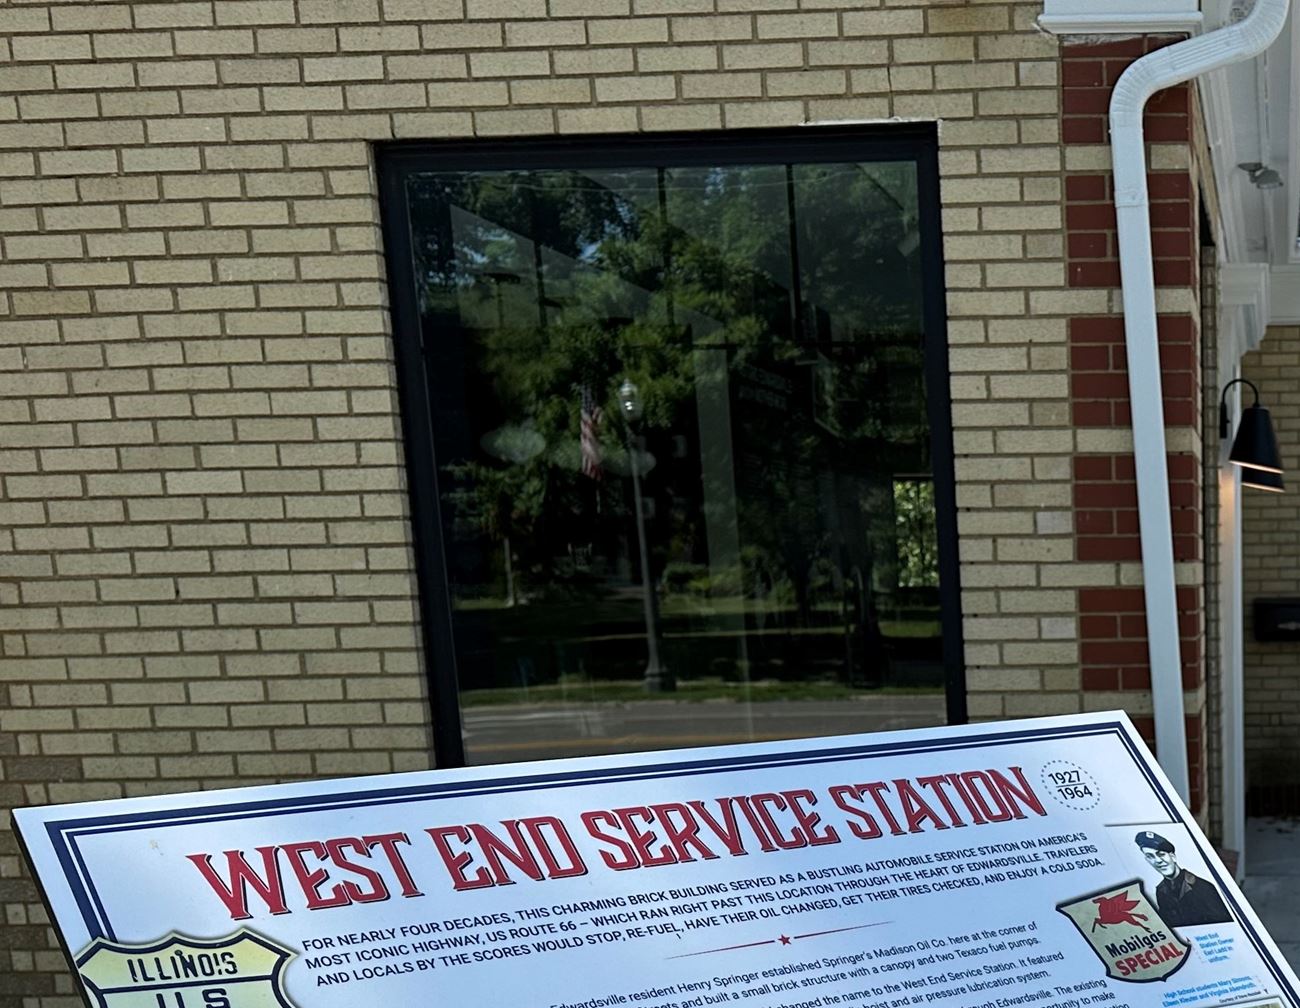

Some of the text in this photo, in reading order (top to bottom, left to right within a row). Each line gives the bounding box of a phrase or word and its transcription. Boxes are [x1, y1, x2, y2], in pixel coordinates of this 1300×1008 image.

[1047, 769, 1085, 787] 1927
[1057, 784, 1093, 800] 1964
[185, 766, 1048, 921] WEST END SERVICE STATION
[301, 832, 1087, 951] FOR NEARLY FOUR DECADES, THIS CHARMING BRICK BUILDING SERVED AS A BUSTLING AUTOMOBILE SERVICE STATION ON AMERICA'S
[628, 985, 677, 1002] resident
[676, 980, 712, 993] Henry
[712, 971, 759, 987] Springer
[761, 959, 822, 978] established
[821, 951, 873, 968] Springer's
[872, 944, 917, 958] Madison
[916, 939, 931, 950] Oil
[930, 938, 949, 948] Co.
[947, 935, 970, 945] here
[970, 932, 982, 941] at
[980, 929, 998, 939] the
[998, 924, 1026, 936] corner
[1027, 920, 1037, 931] of
[1105, 930, 1167, 958] Mobilgas
[1115, 942, 1184, 976] SPECIAL
[127, 952, 238, 983] ILLINOIS
[890, 995, 910, 1008] and
[910, 993, 924, 1003] air
[925, 986, 967, 1003] pressure
[965, 976, 1016, 992] lubrication
[1015, 970, 1051, 983] system.
